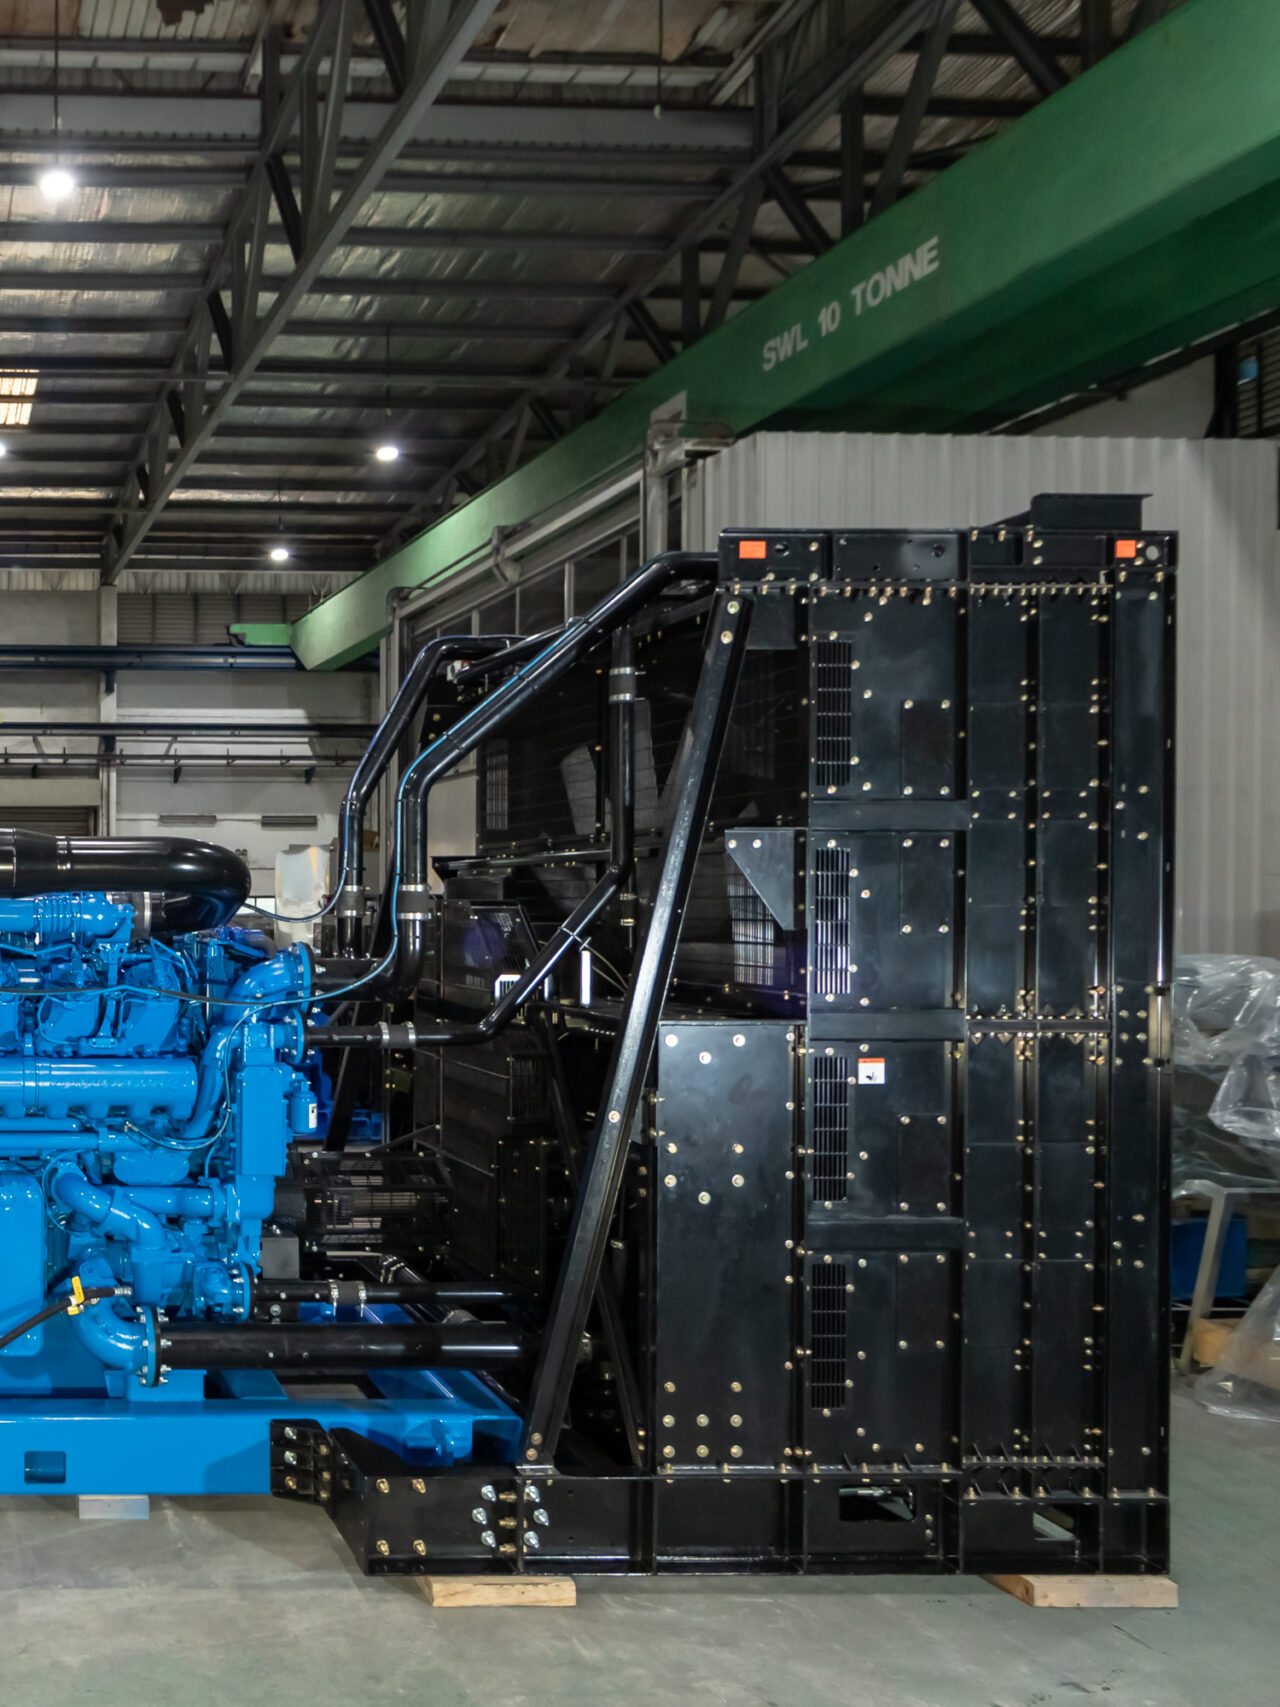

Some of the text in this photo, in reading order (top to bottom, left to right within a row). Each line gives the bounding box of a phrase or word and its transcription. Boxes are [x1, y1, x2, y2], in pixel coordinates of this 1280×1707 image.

[762, 235, 940, 371] SWL 10 TONNE
